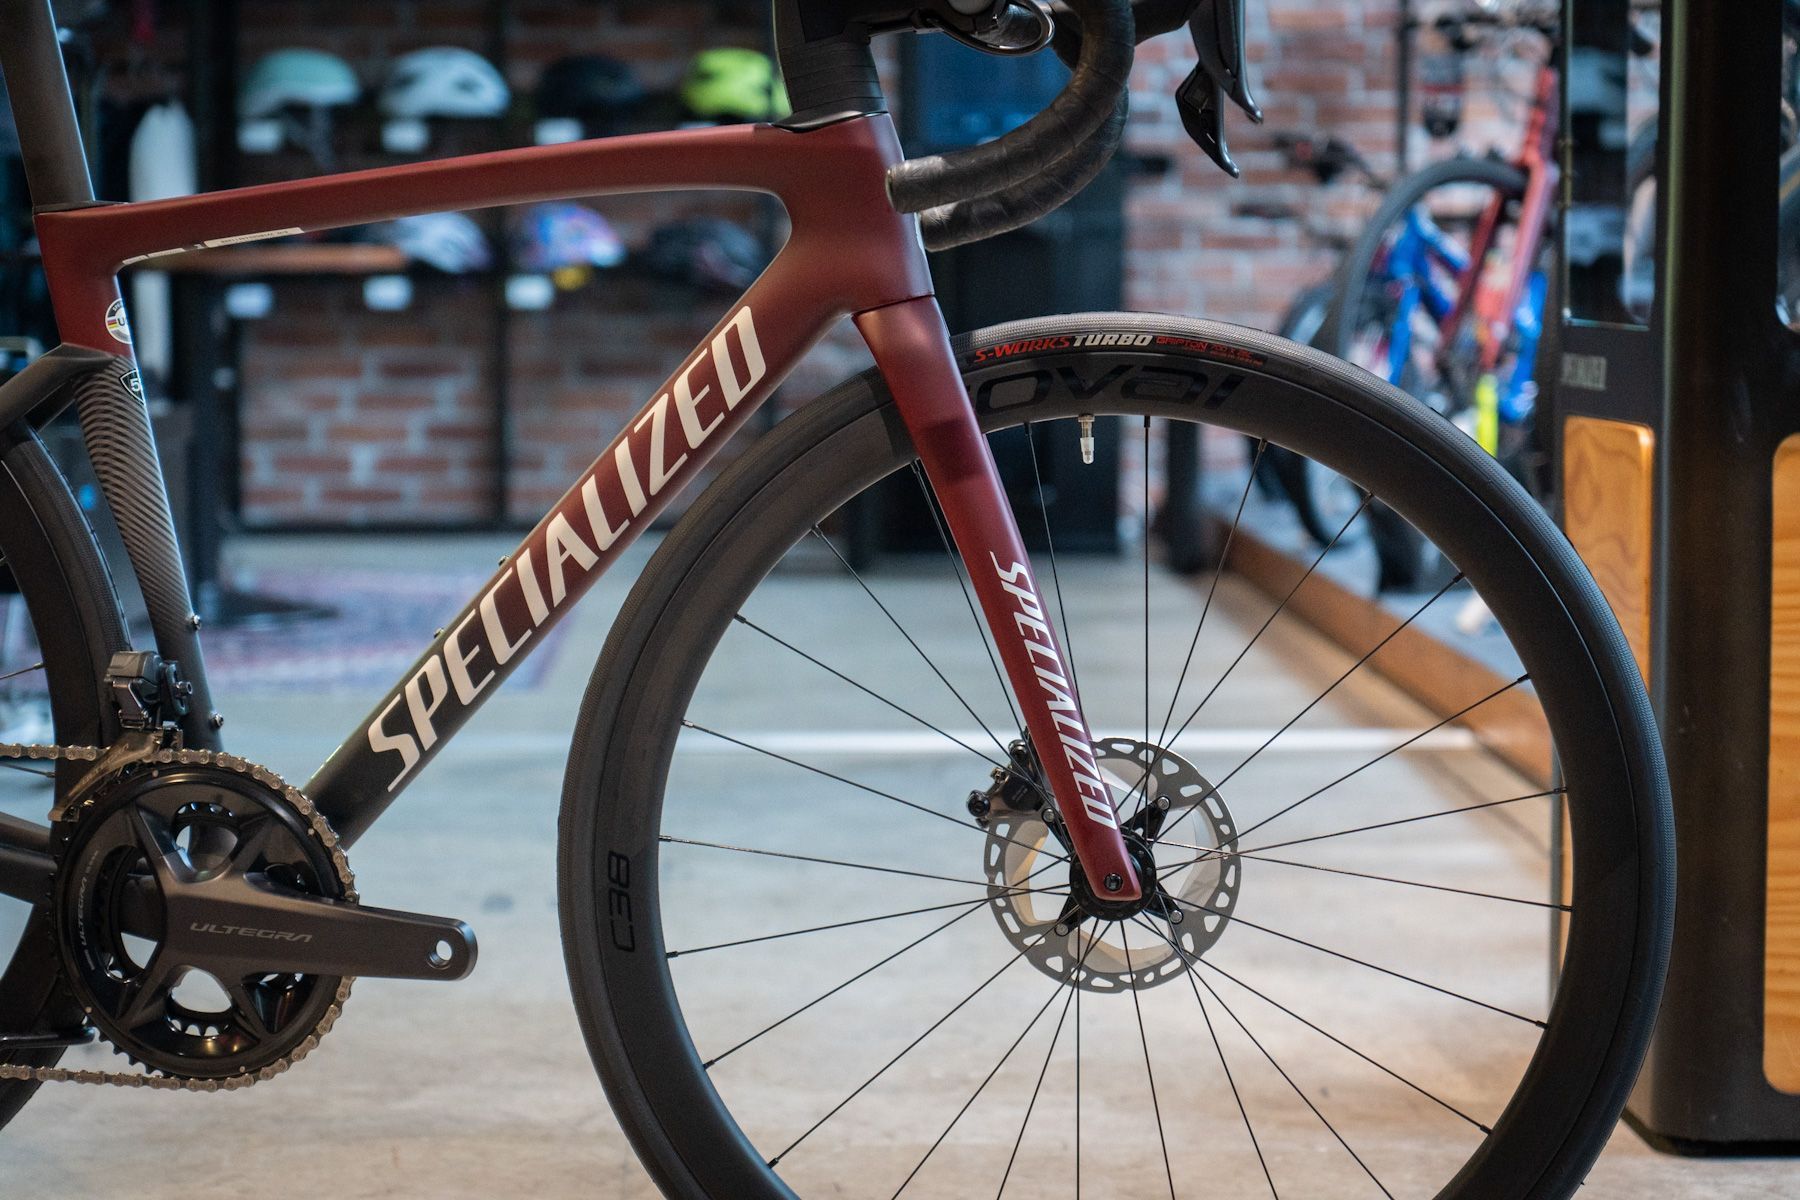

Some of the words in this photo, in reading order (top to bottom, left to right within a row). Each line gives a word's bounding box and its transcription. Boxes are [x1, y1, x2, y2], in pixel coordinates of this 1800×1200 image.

[973, 335, 1072, 363] S-WORKS
[1073, 334, 1153, 347] TURBO
[973, 364, 1246, 416] oval
[367, 305, 766, 792] SPECIALIZED
[990, 550, 1118, 830] SPECIALIZED
[77, 876, 88, 946] ULTEGRA
[190, 922, 312, 942] ULTEGRA
[607, 850, 635, 952] C38
